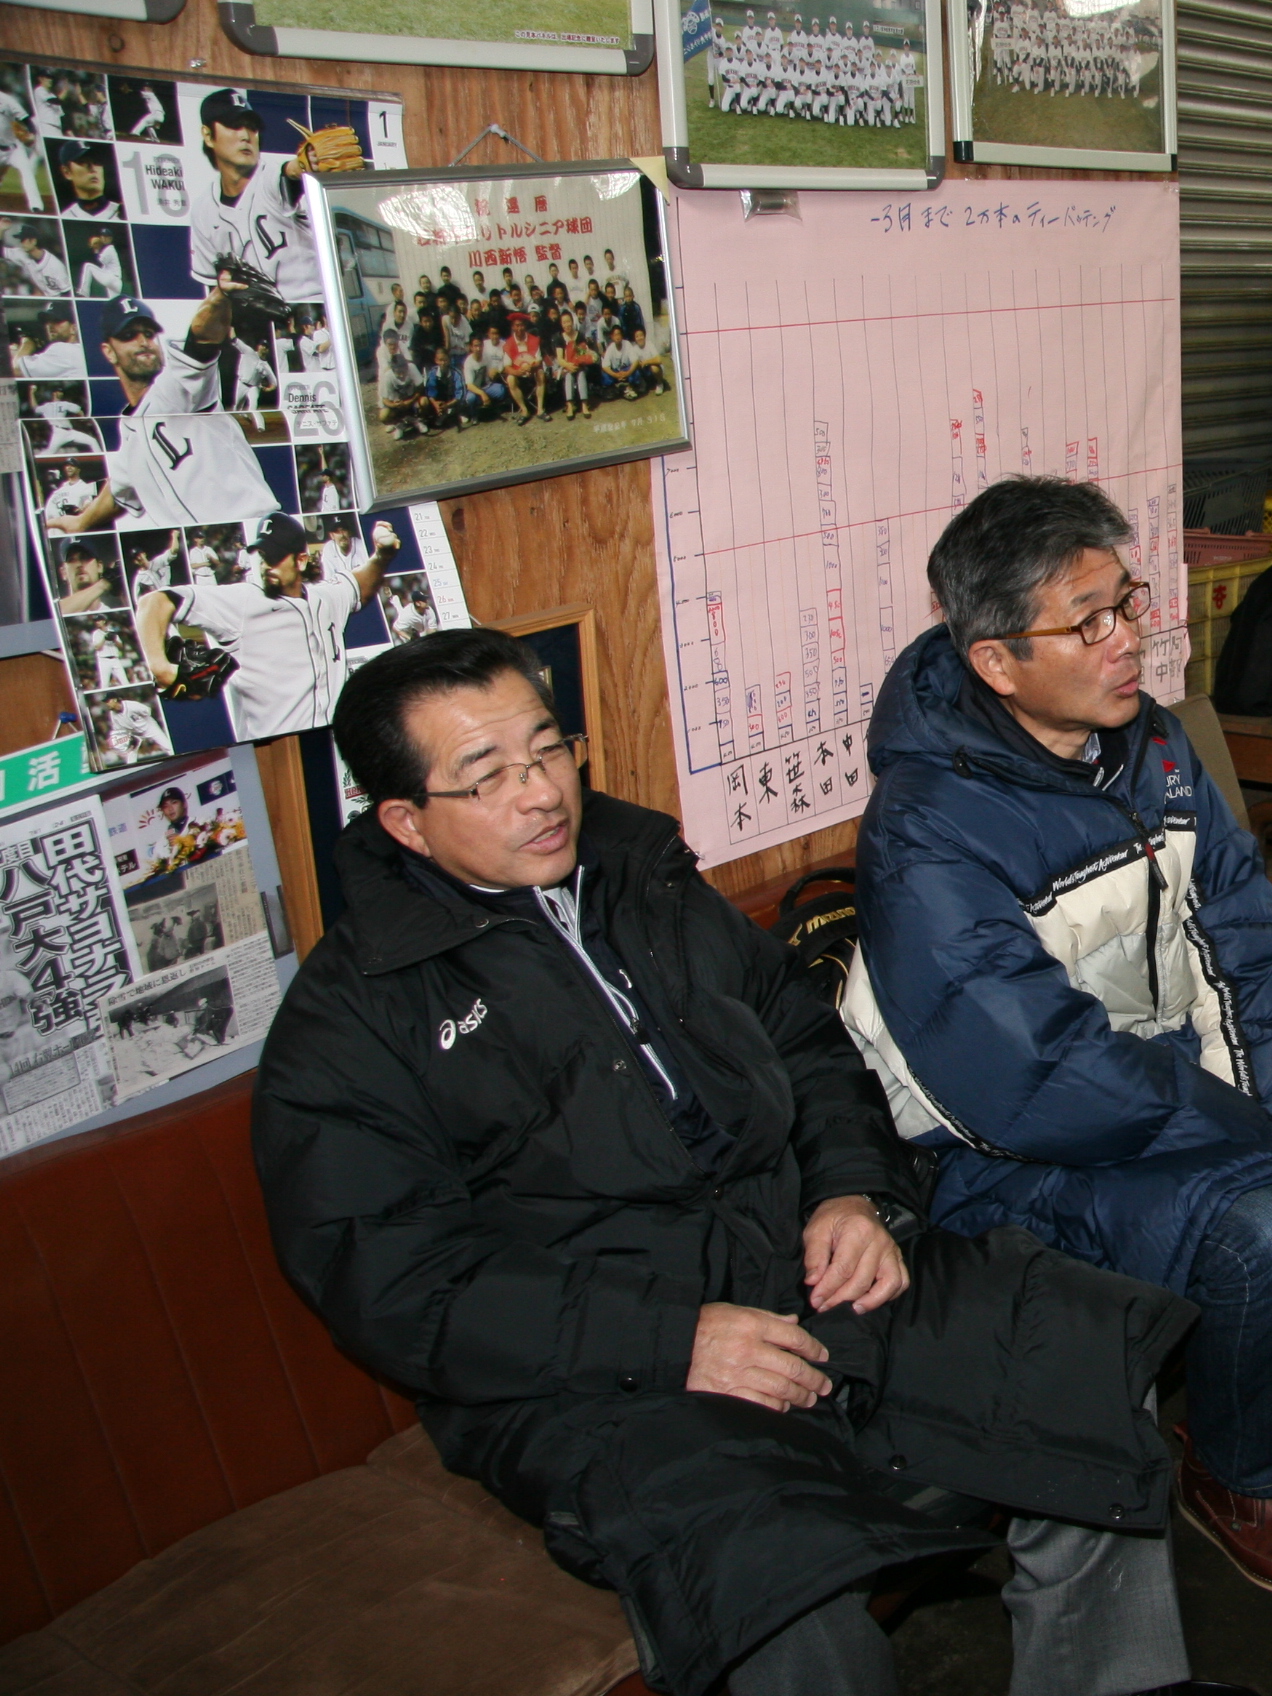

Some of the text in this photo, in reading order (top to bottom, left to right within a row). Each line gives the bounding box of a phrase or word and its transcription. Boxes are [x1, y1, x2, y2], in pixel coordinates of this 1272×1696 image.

[379, 110, 389, 139] 1
[145, 164, 184, 177] Hideaki
[150, 178, 186, 192] WAKUI
[288, 392, 317, 403] Dennis
[414, 511, 424, 521] 21
[419, 528, 429, 538] 22
[423, 545, 433, 554] 23
[428, 562, 438, 571] 24
[432, 578, 442, 588] 25
[437, 595, 447, 604] 26
[442, 611, 451, 621] 27
[758, 761, 779, 805] 東
[726, 763, 753, 832] 岡本
[0, 839, 34, 863] 度目
[457, 998, 488, 1035] asics
